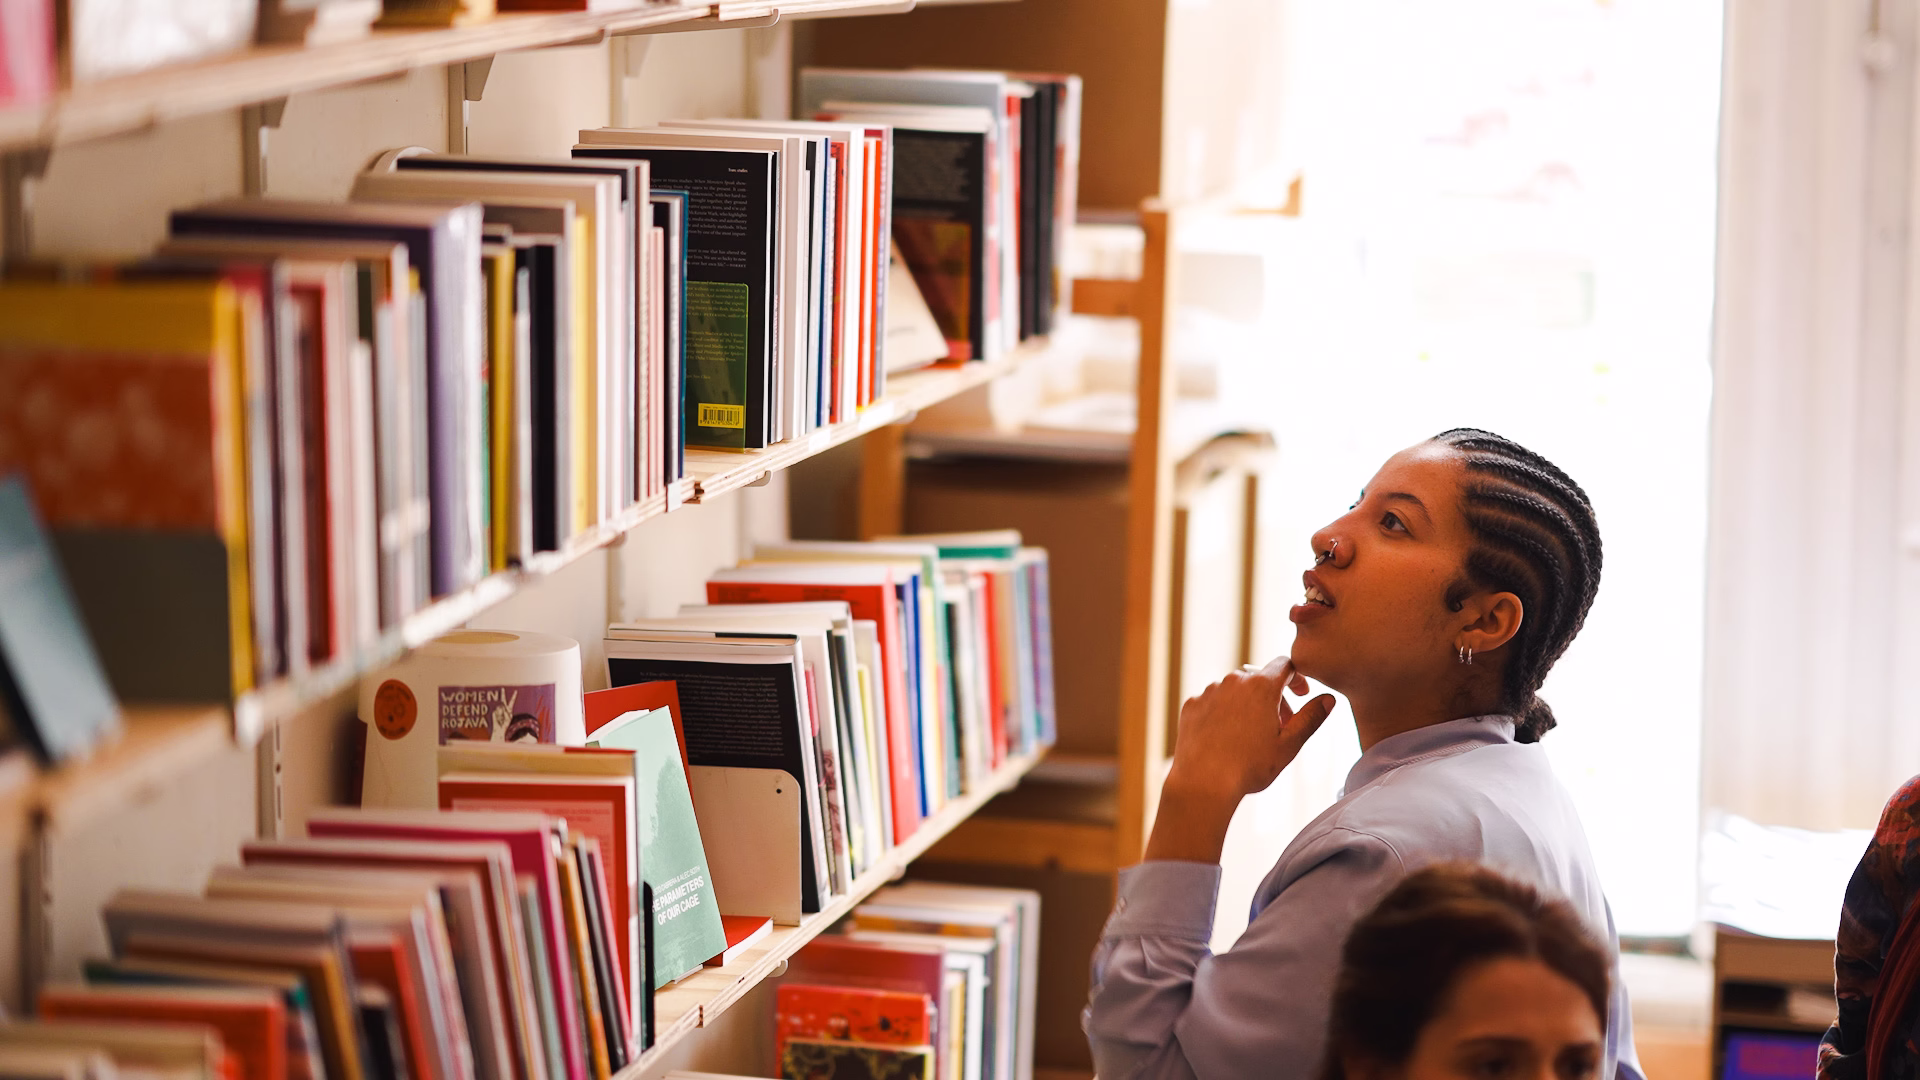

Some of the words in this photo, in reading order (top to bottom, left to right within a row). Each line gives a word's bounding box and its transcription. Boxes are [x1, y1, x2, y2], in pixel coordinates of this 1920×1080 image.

[441, 690, 499, 702] WOMEN
[442, 704, 488, 716] DEFEND
[442, 717, 488, 728] ROJAVA
[660, 876, 704, 908] PARAMETERS
[658, 911, 667, 925] OF
[667, 904, 681, 920] OUR
[680, 894, 700, 912] CAGE
